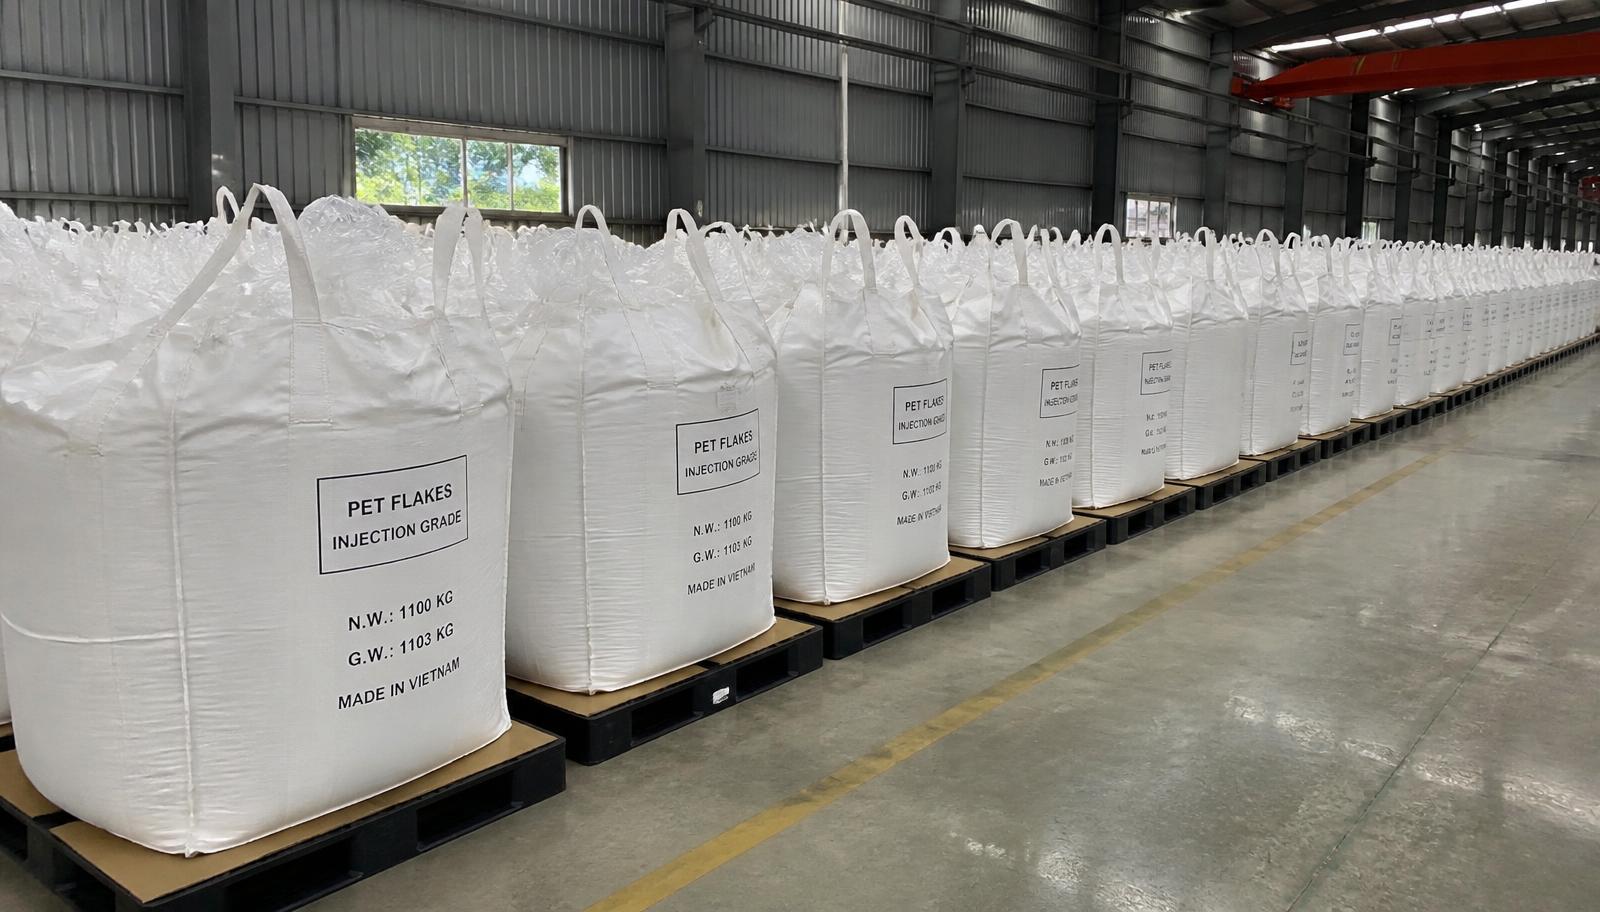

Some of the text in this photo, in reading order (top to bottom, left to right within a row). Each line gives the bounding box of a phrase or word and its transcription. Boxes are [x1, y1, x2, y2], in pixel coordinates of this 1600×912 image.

[1050, 380, 1063, 390] PET
[905, 400, 921, 412] PET
[694, 430, 753, 454] PET FLAKES
[685, 459, 734, 478] INJECTION
[348, 483, 453, 517] PET FLAKES
[332, 510, 462, 550] INJECTION GRADE
[693, 510, 752, 536] N.W.: 1100 KG
[693, 548, 720, 563] G.W.:
[724, 541, 741, 555] 1103
[687, 579, 715, 595] MADE
[717, 575, 726, 587] IN
[348, 590, 453, 631] N.W.: 1100 KG
[348, 622, 454, 666] G.W.: 1103 KG
[338, 656, 460, 710] MADE IN VIETNAM
